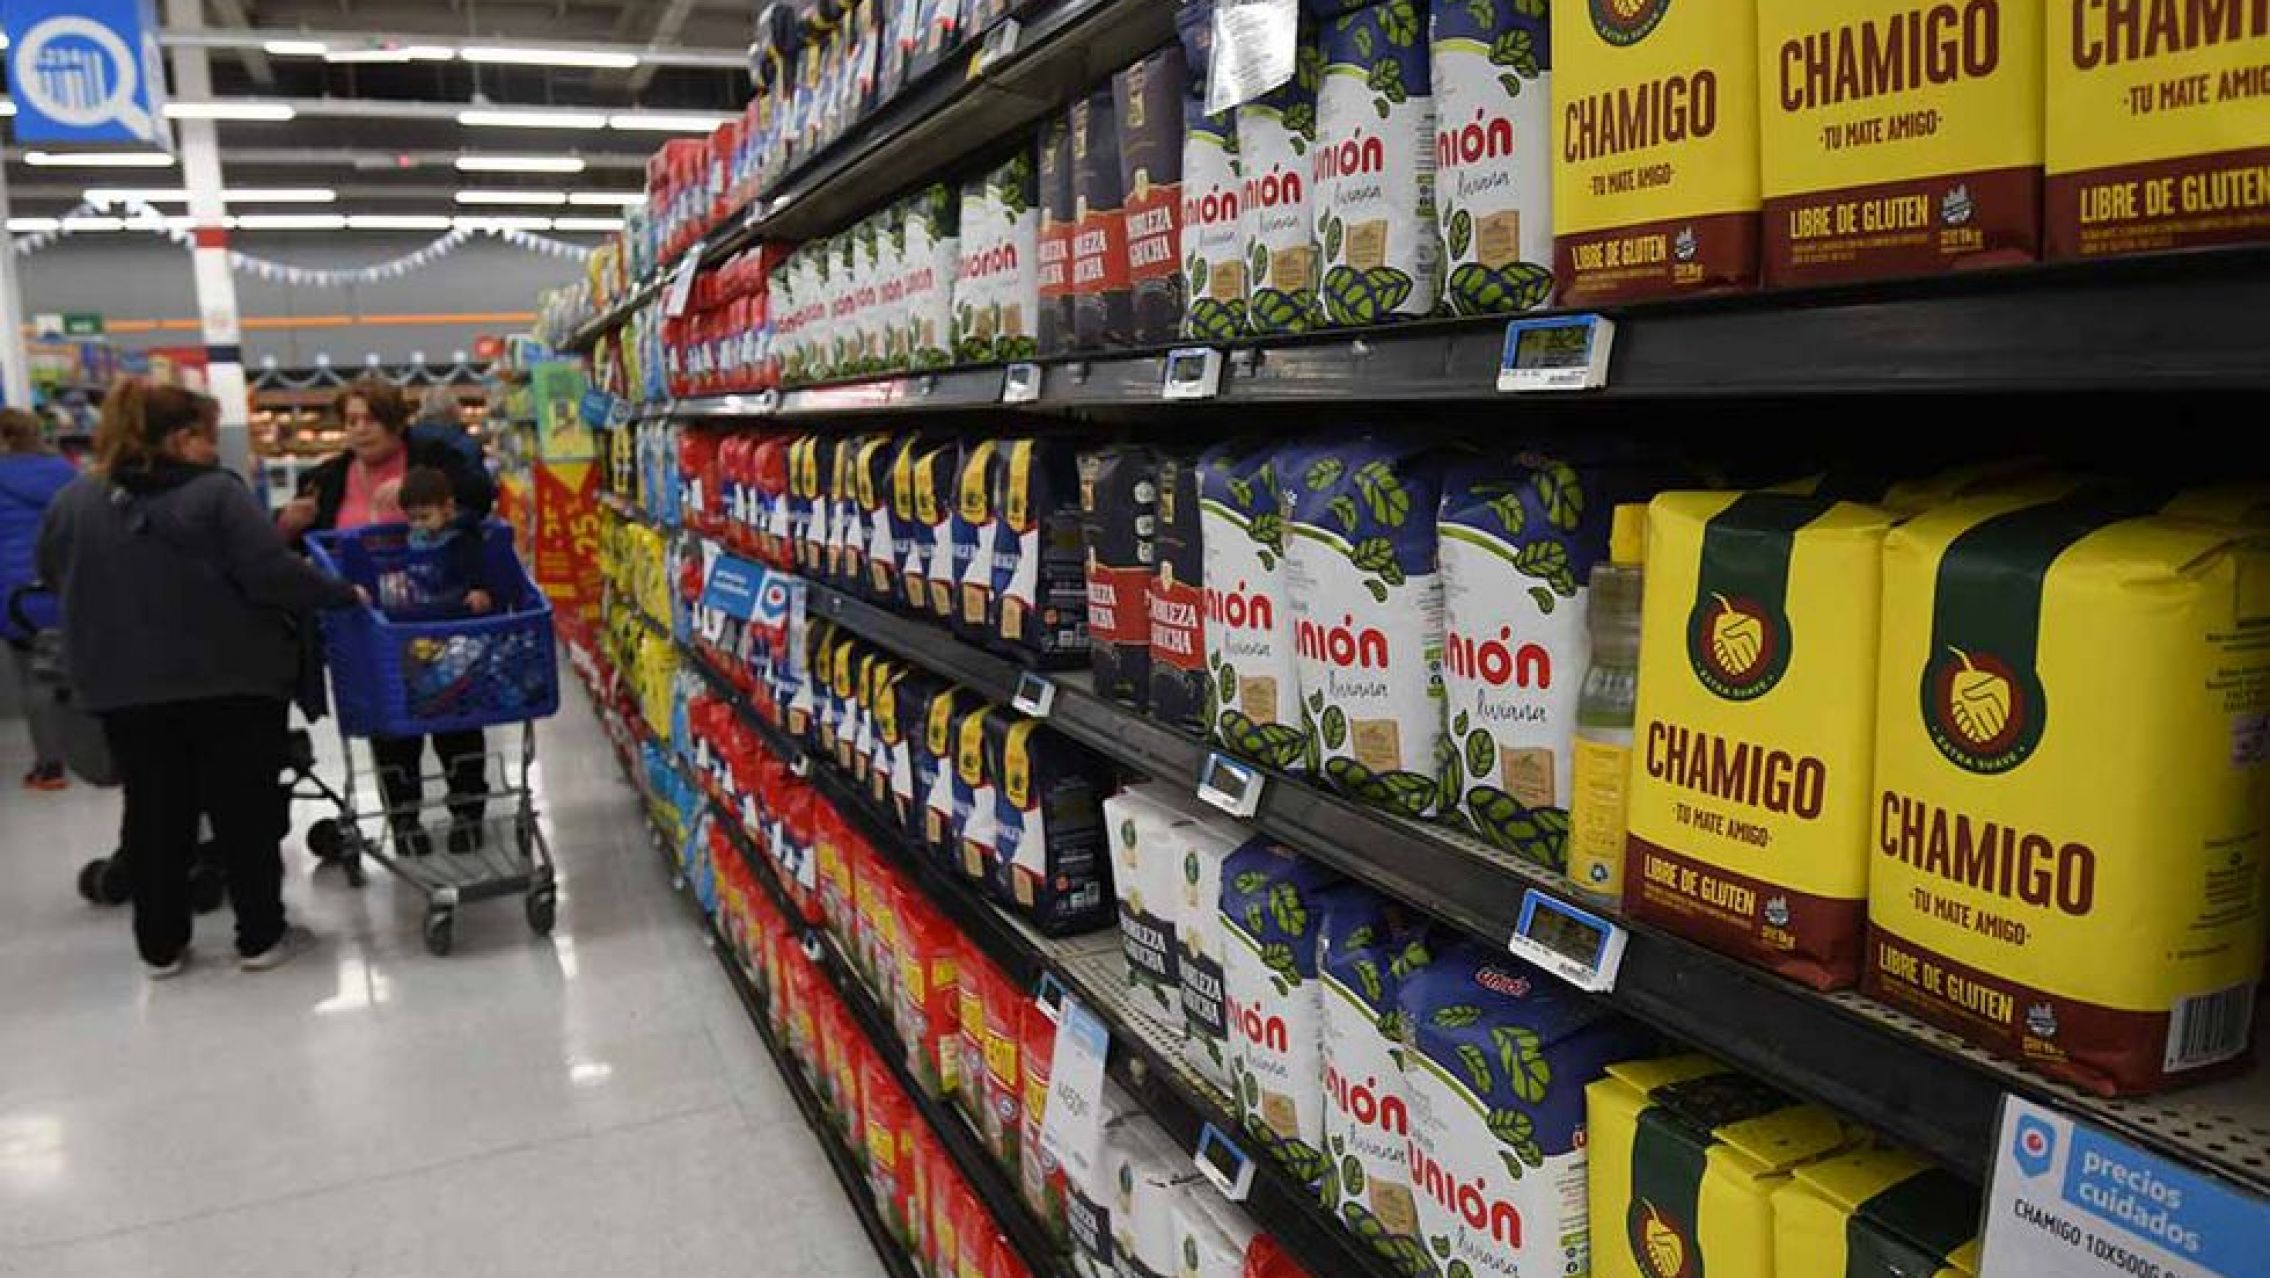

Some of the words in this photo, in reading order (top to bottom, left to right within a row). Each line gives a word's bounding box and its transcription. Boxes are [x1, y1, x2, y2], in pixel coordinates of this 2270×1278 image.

[1780, 0, 1999, 112] CHAMIGO
[1565, 70, 1716, 162] CHAMIGO
[2159, 74, 2210, 110] MATE
[1846, 118, 1883, 146] MATE
[1790, 206, 1831, 240] LIBRE
[1837, 203, 1857, 234] DE
[1863, 194, 1929, 231] GLUTEN
[2080, 183, 2138, 223] LIBRE
[2145, 178, 2175, 216] DE
[2182, 166, 2270, 212] GLUTEN
[1572, 240, 1604, 271] LIBRE
[1606, 238, 1620, 267] DE
[1622, 233, 1667, 267] GLUTEN
[1647, 719, 1827, 820] CHAMIGO
[1693, 808, 1724, 836] MATE
[1880, 790, 2096, 917] CHAMIGO
[1644, 854, 1679, 890] LIBRE
[1681, 867, 1699, 897] DE
[1702, 875, 1757, 917] GLUTEN
[1934, 895, 1972, 930] MATE
[1880, 942, 1920, 985] LIBRE
[1922, 962, 1944, 996] DE
[1948, 972, 2015, 1025] GLUTEN
[2083, 1151, 2184, 1210] precios
[2013, 1198, 2082, 1247] CHAMIGO
[2078, 1182, 2201, 1253] cuidados
